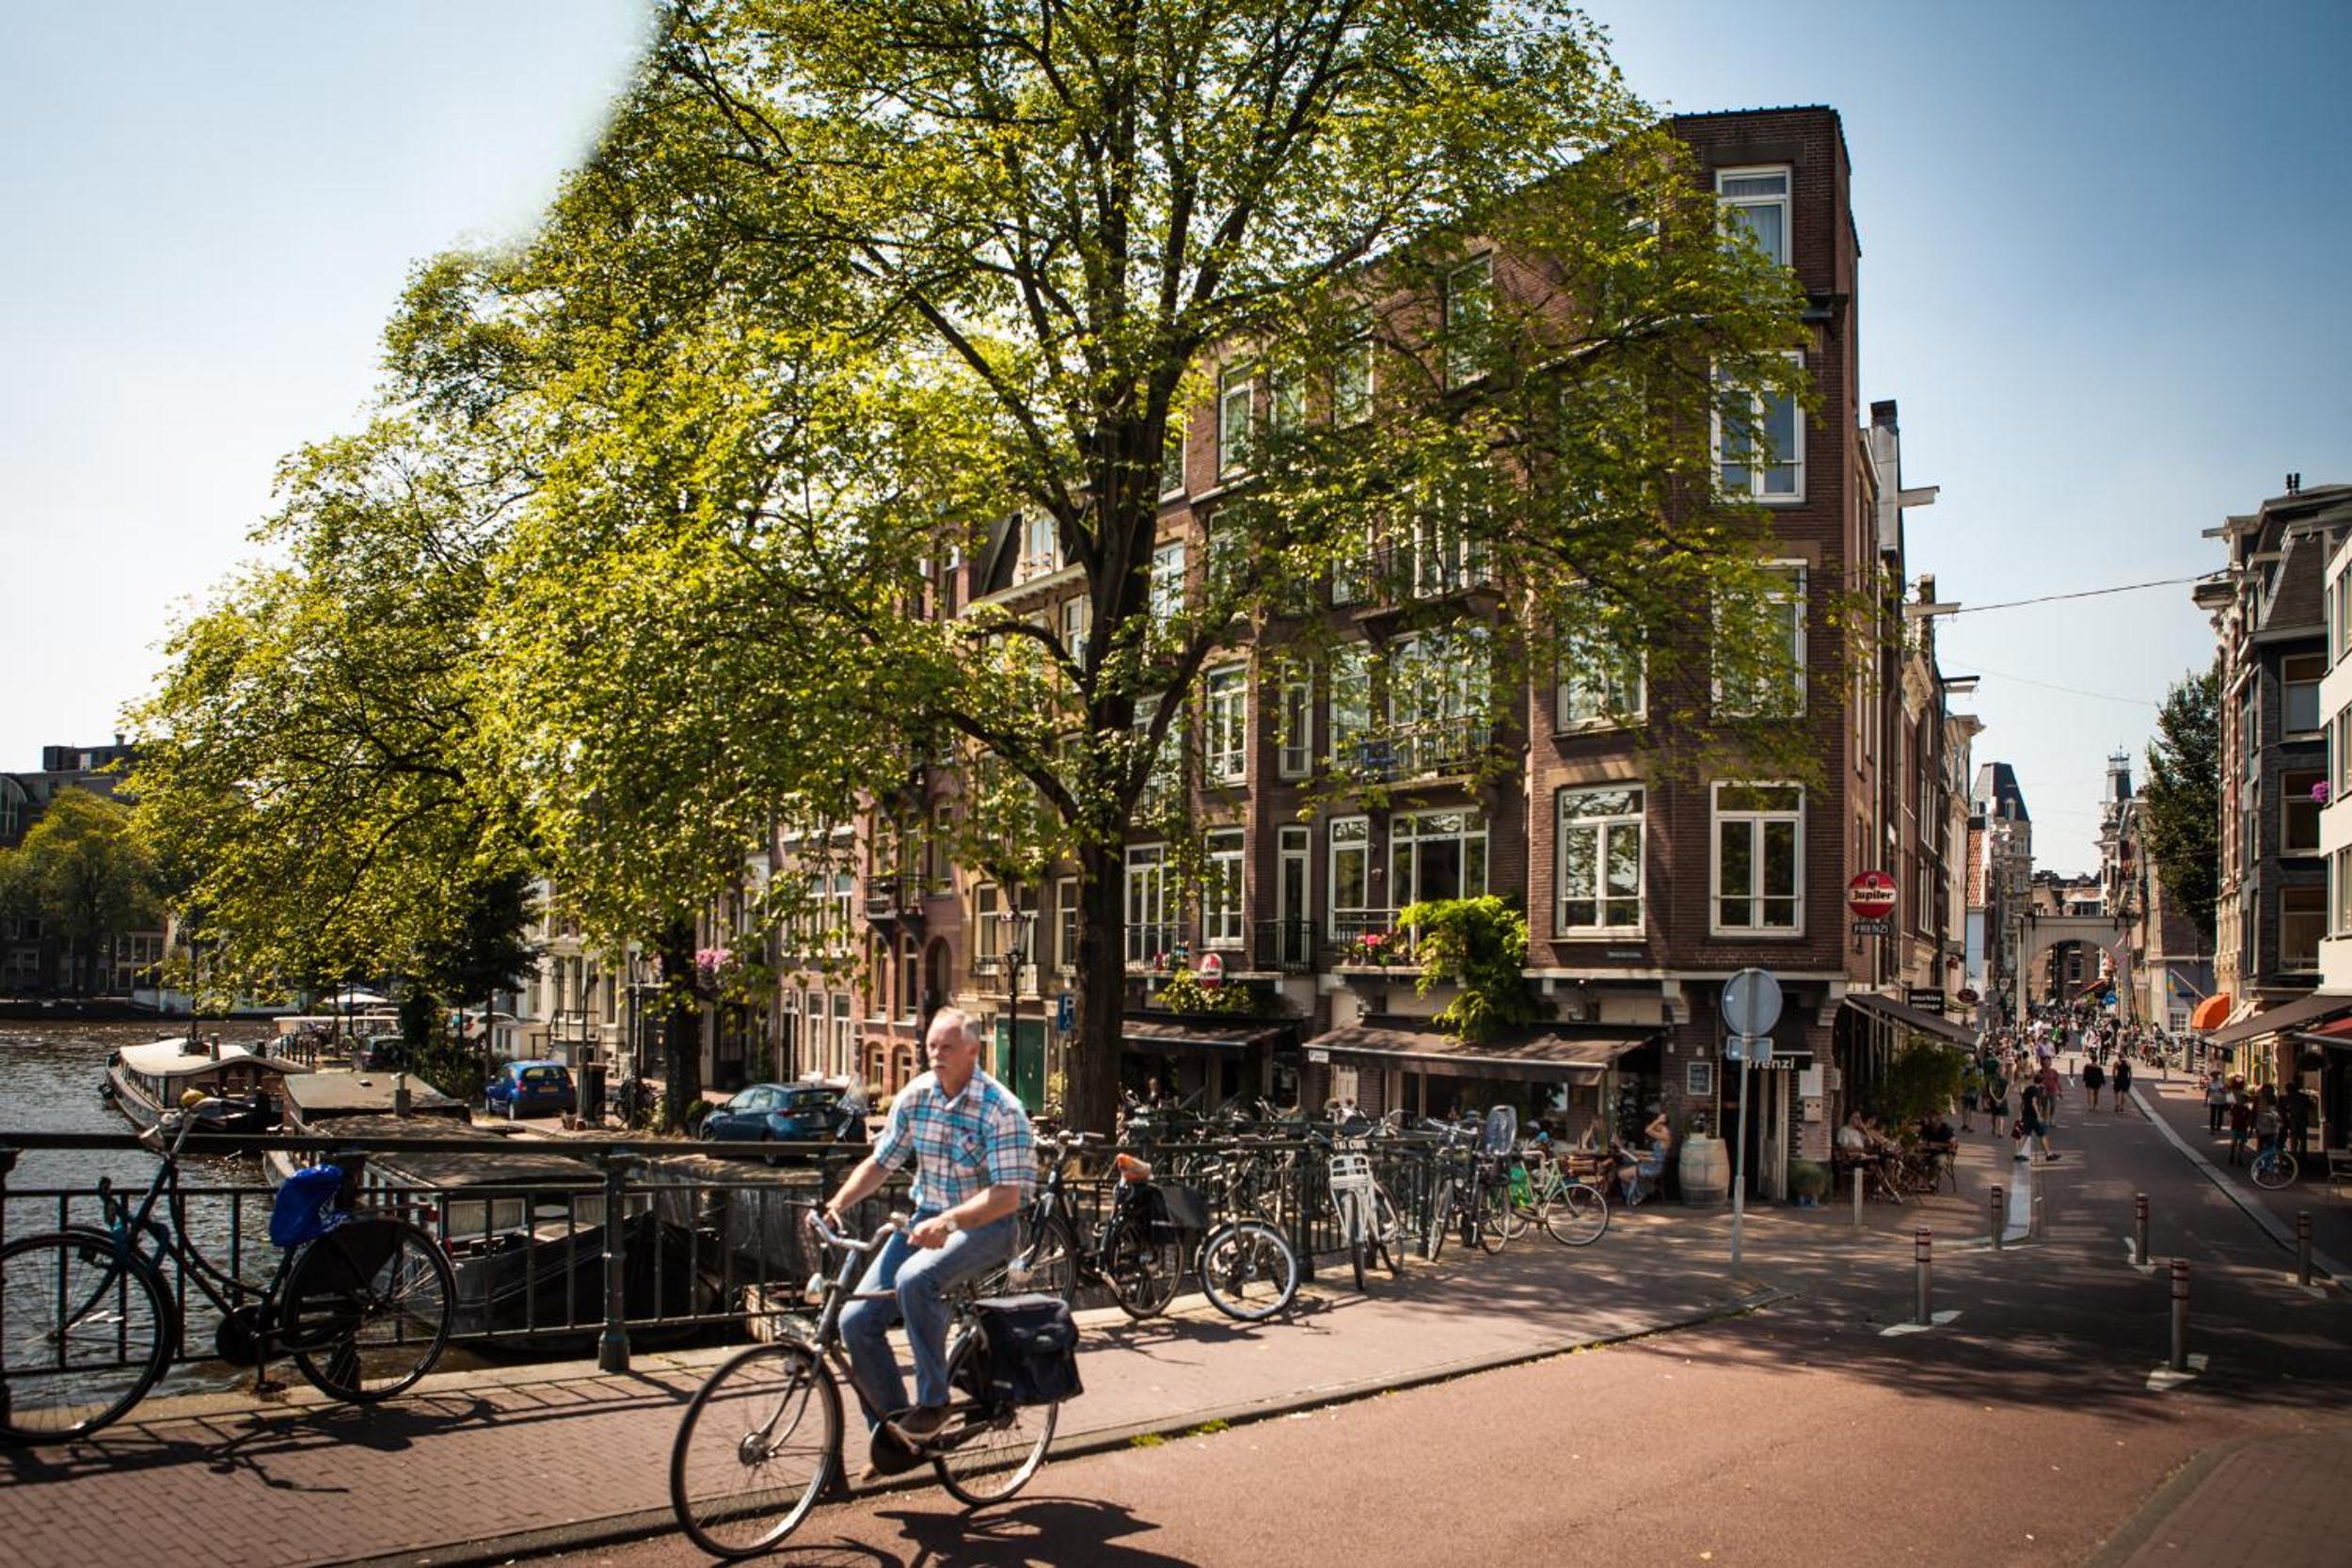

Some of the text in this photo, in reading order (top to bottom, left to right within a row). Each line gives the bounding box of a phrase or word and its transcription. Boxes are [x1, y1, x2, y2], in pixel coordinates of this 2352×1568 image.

[1853, 890, 1893, 901] Jupiler
[1854, 925, 1888, 933] FRENZI
[1063, 996, 1075, 1014] P
